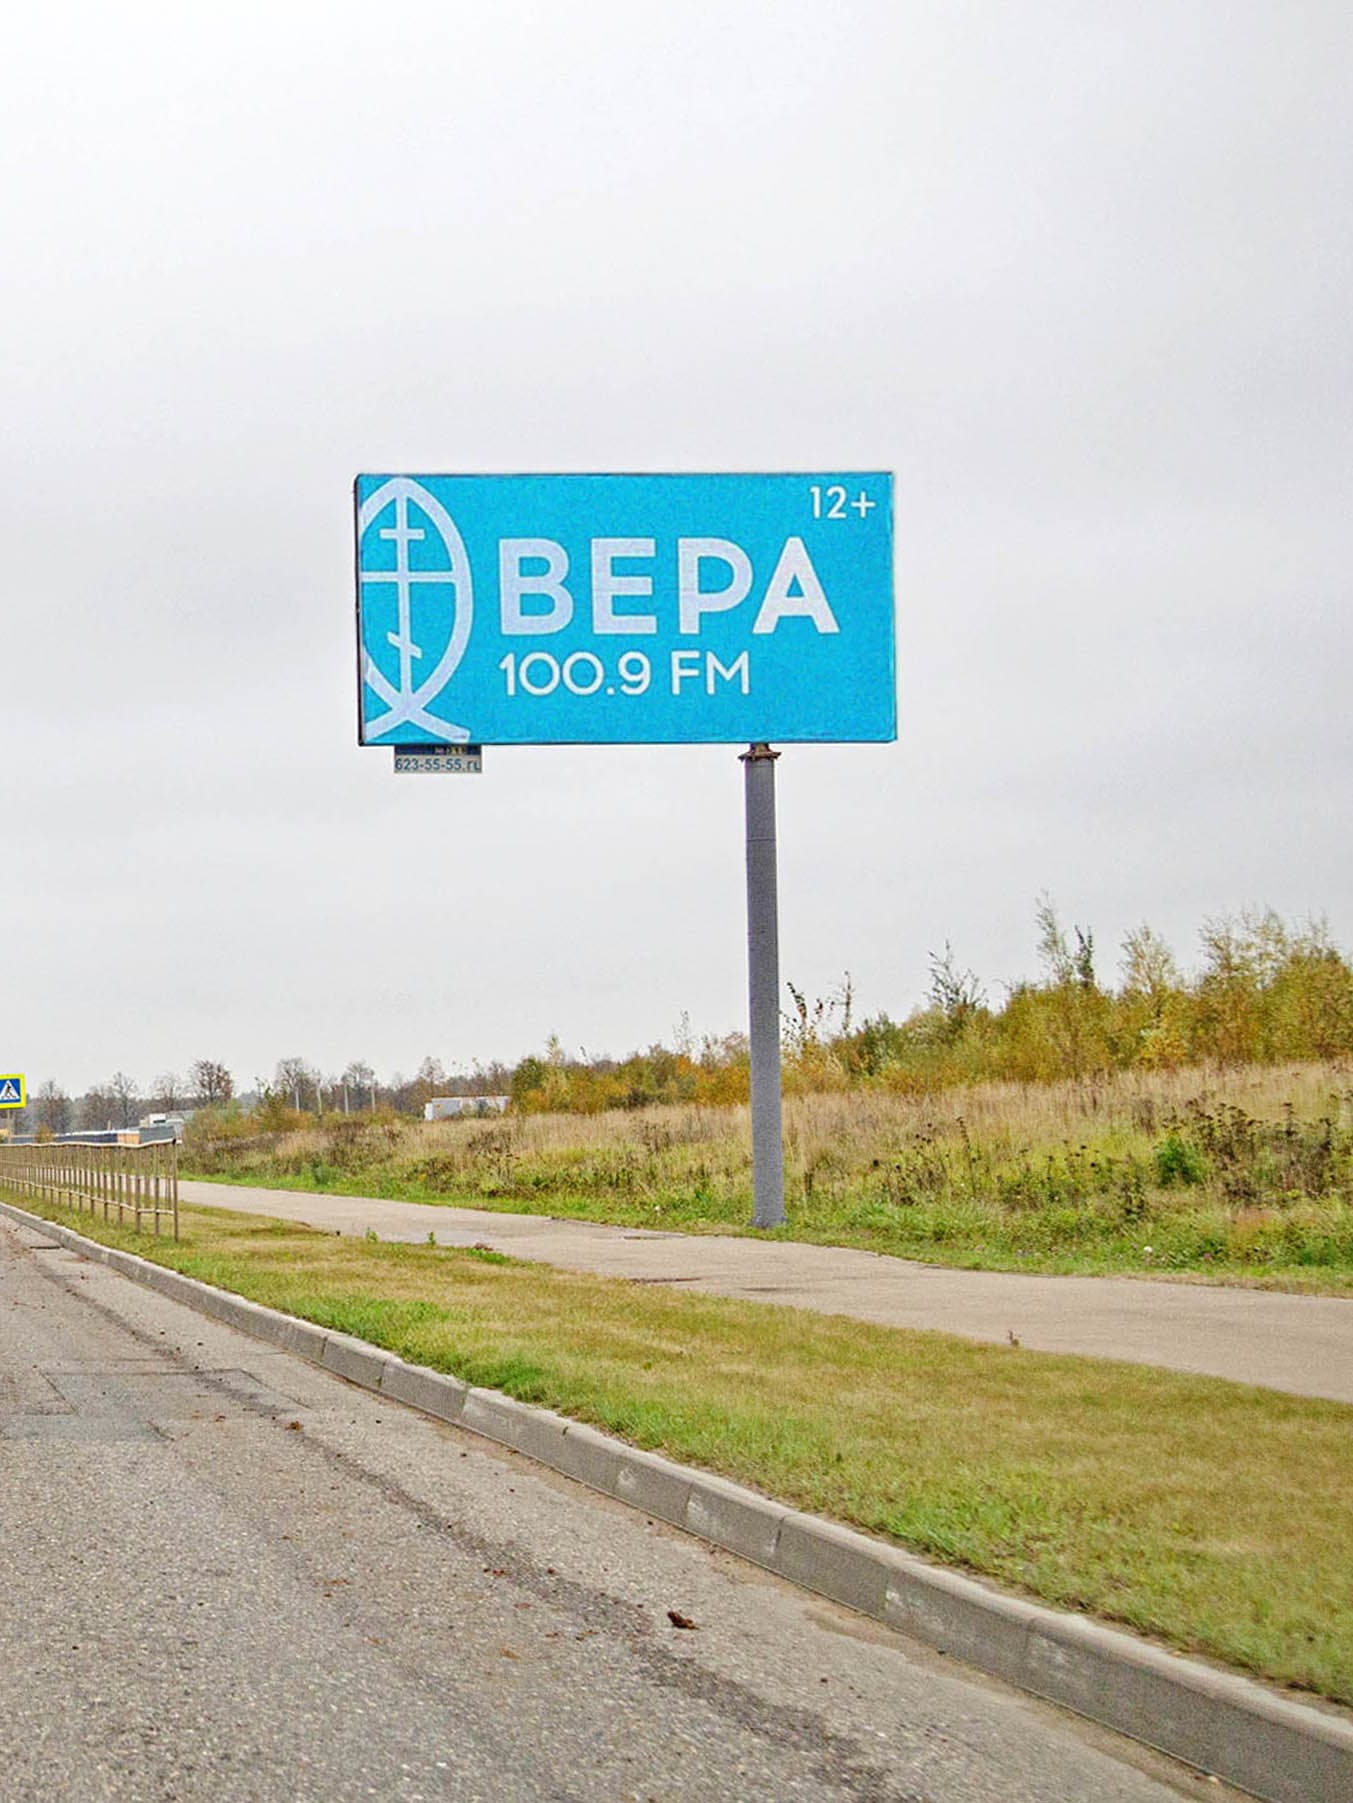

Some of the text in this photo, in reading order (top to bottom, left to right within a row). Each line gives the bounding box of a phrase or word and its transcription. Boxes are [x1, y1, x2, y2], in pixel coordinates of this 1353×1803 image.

[810, 486, 876, 519] 12+
[499, 537, 840, 635] ВЕРА
[499, 650, 751, 696] 100.9 FM
[395, 758, 481, 771] 623-55-55.ru
